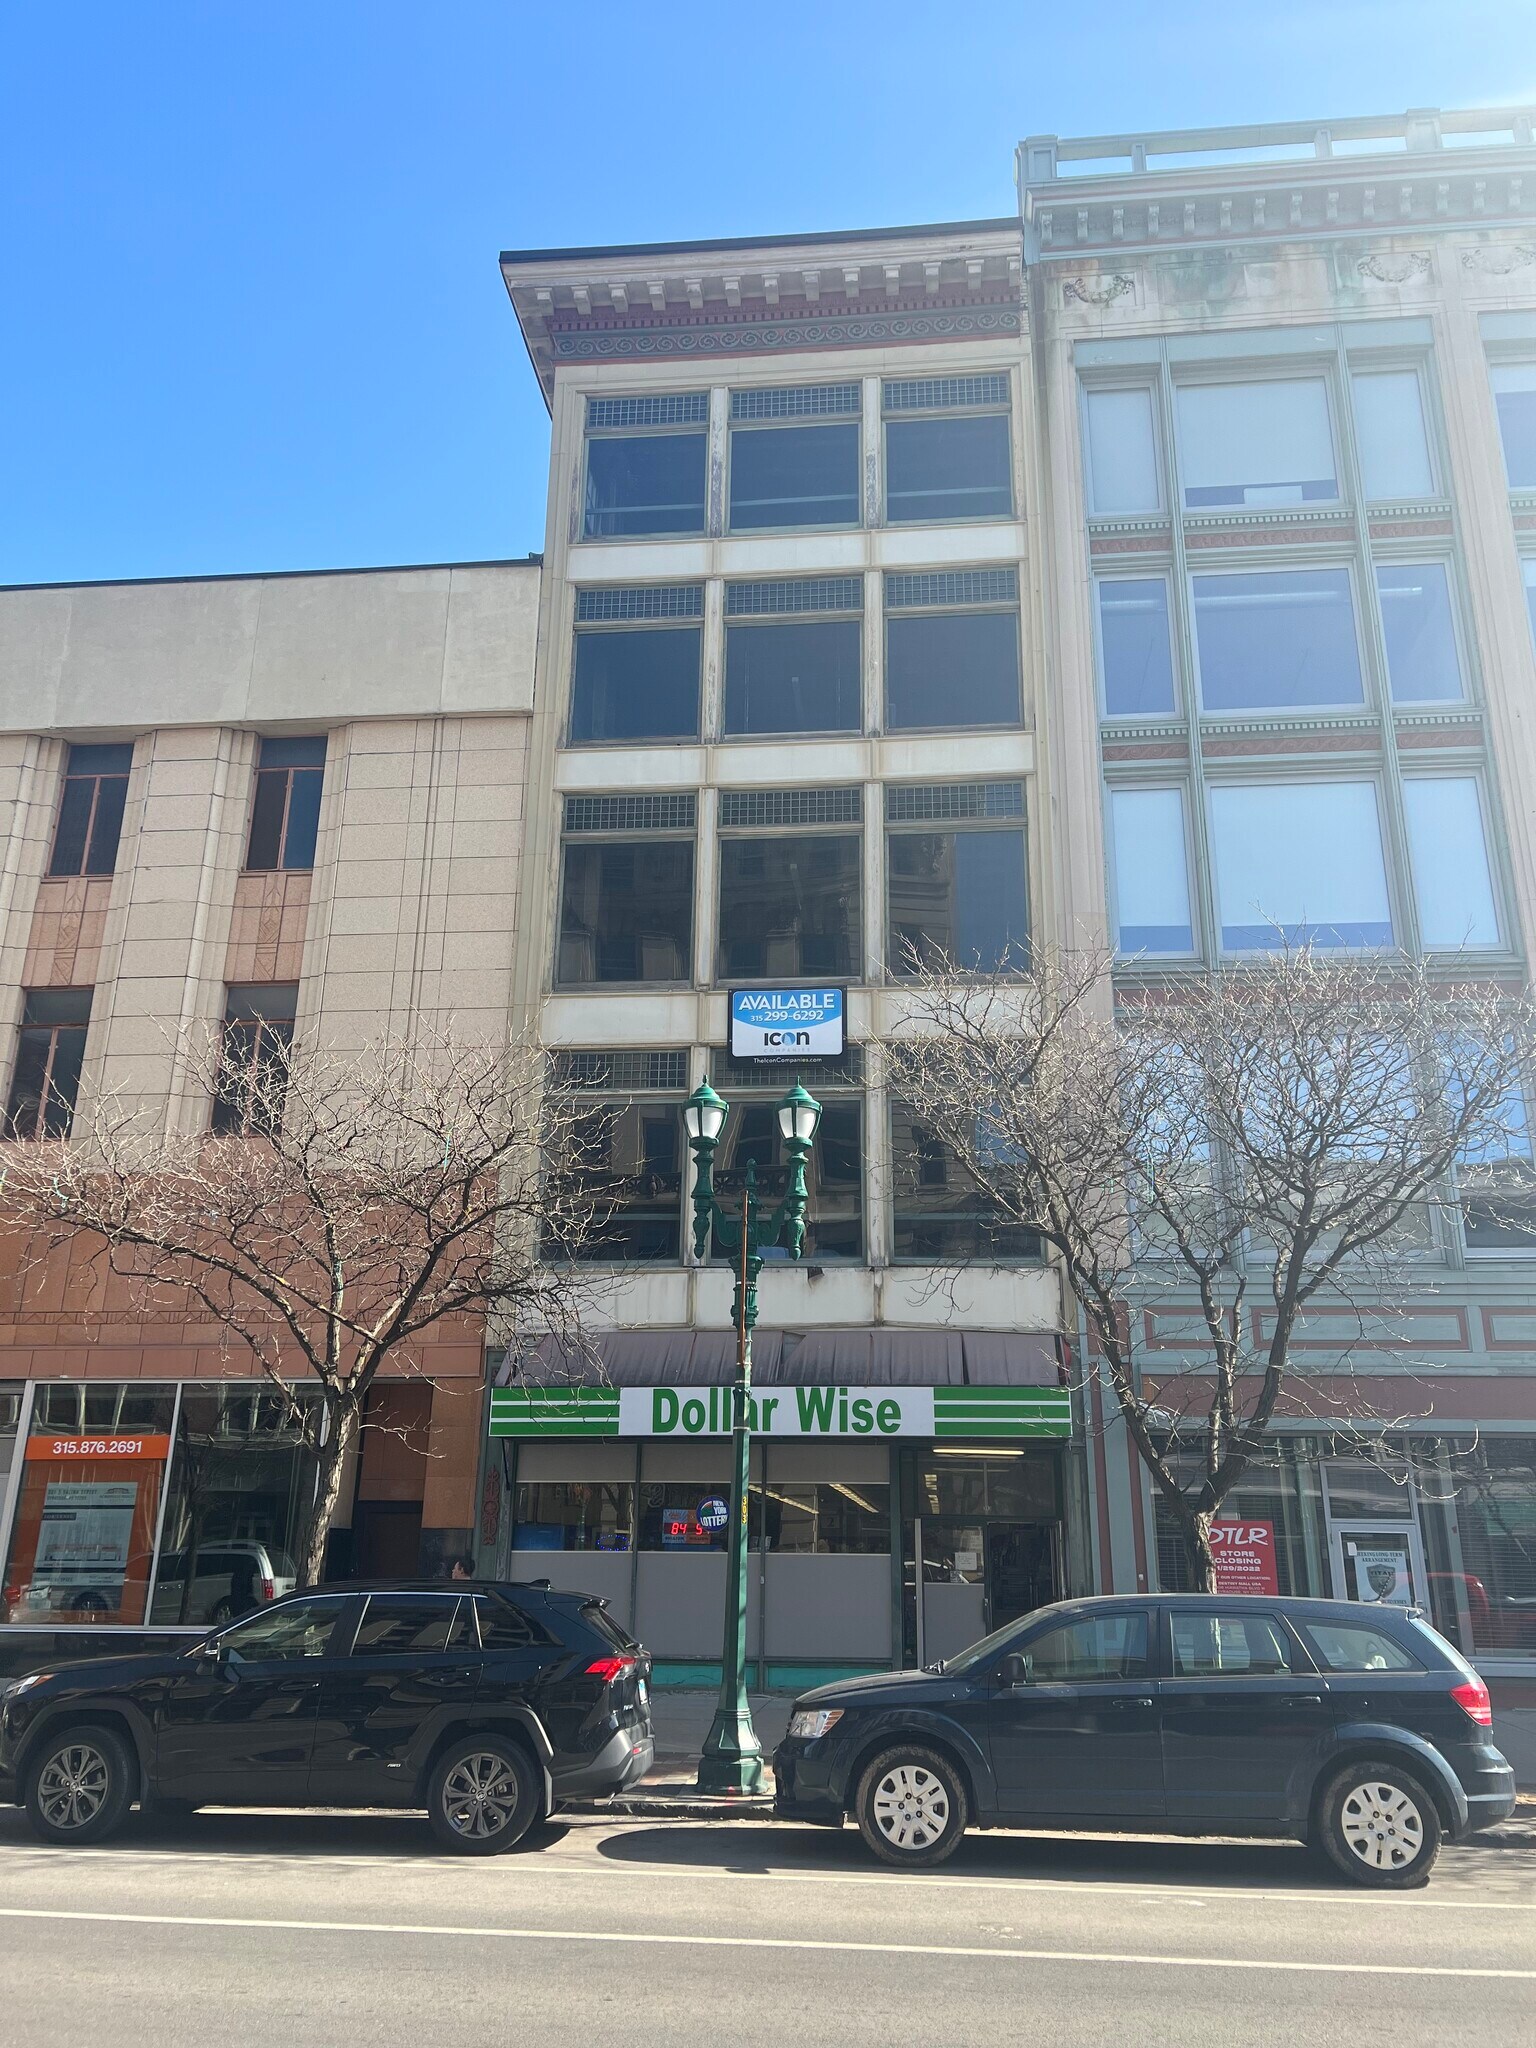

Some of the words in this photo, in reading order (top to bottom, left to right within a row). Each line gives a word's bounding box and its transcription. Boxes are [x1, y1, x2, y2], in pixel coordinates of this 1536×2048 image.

[738, 993, 835, 1011] AVAILABLE
[764, 1010, 824, 1022] 299-6292
[754, 1057, 822, 1065] TheIconCompanies.com
[795, 1387, 901, 1433] Wise
[53, 1441, 142, 1454] 315.876.2691
[713, 1506, 727, 1515] YORK
[700, 1515, 728, 1527] LOTTERY
[671, 1522, 688, 1535] 84
[1209, 1527, 1268, 1546] DTLR
